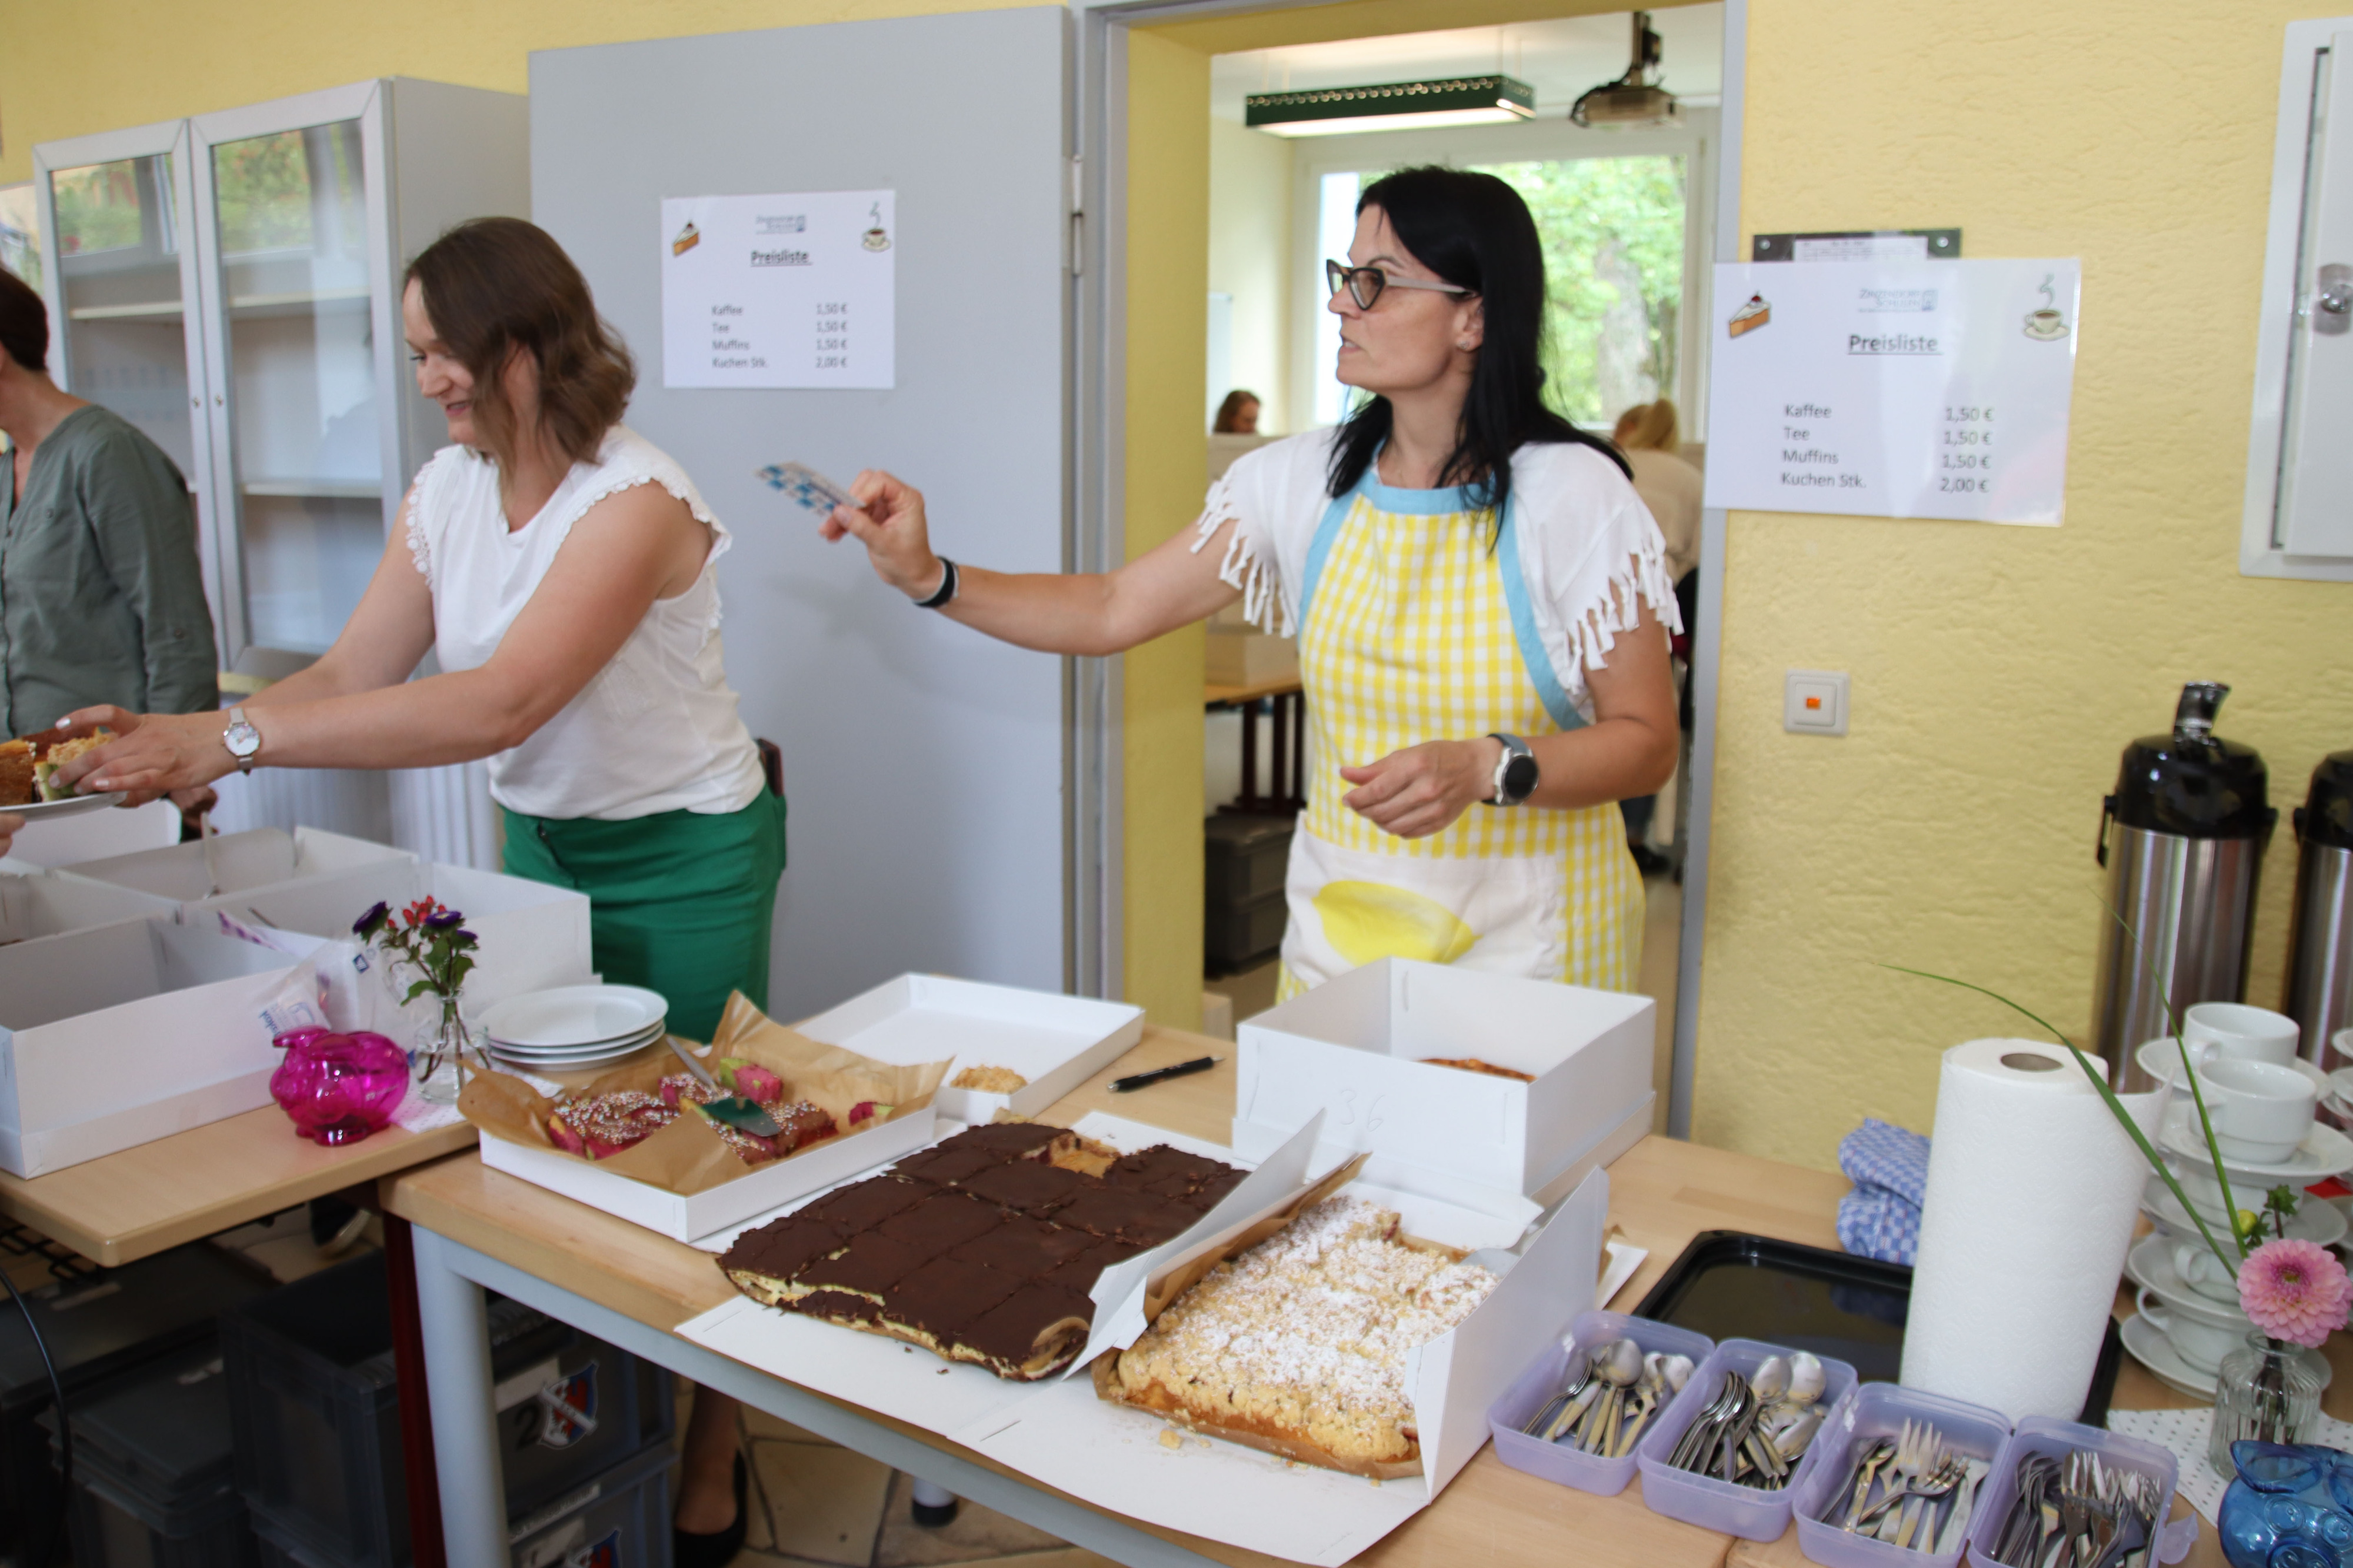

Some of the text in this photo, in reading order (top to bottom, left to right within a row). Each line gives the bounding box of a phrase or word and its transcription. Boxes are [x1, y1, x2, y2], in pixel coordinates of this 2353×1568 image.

[751, 249, 810, 265] Preisliste
[711, 303, 847, 316] Kaffee 1,50 €
[712, 320, 847, 333] Tee 1,50 €
[712, 338, 847, 351] Muffins 1,50 €
[1849, 334, 1939, 352] Preisliste
[712, 358, 748, 368] Kuchen
[816, 356, 838, 369] 2,00
[841, 356, 846, 368] €
[1784, 403, 1993, 423] Kaffee 1,50 €
[1784, 426, 1991, 446] Tee 1,50 €
[1782, 449, 1989, 470] Muffins 1,50 €
[1781, 472, 1988, 493] Kuchen Stk. 2,00 €
[1340, 1088, 1386, 1133] 36
